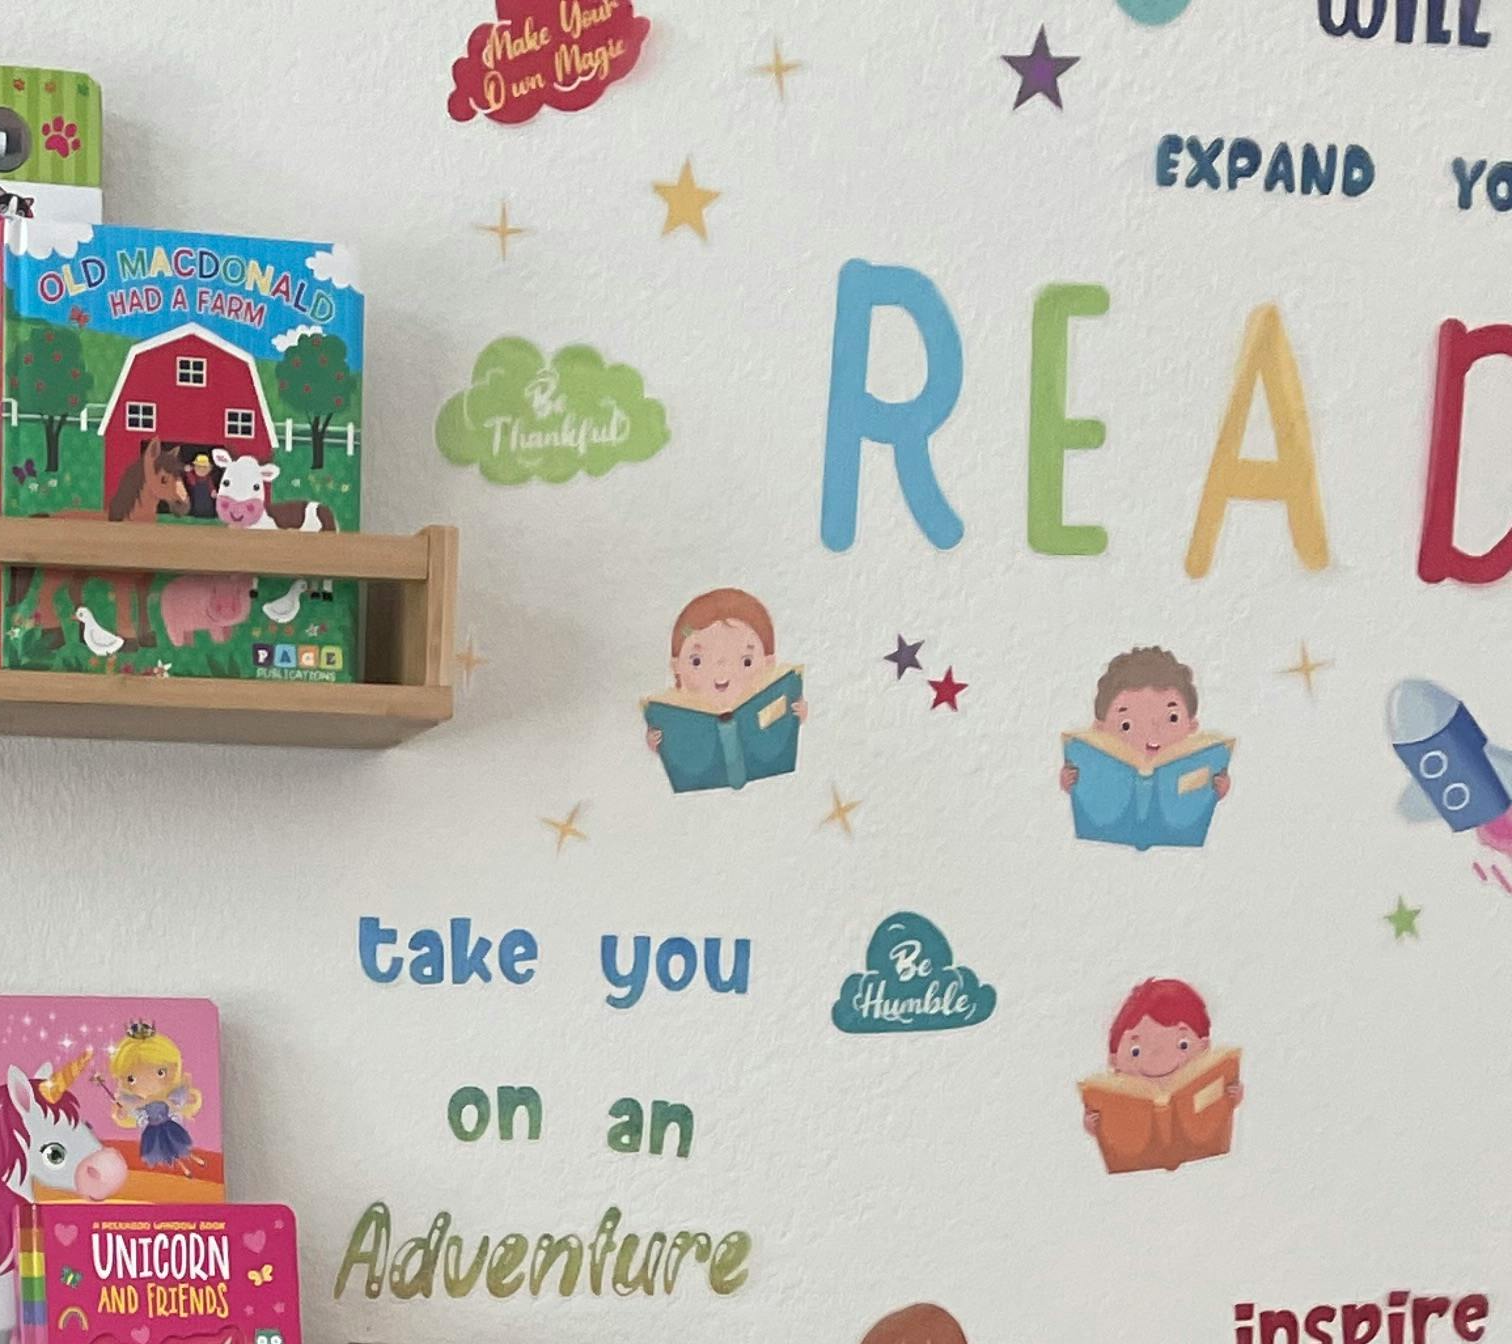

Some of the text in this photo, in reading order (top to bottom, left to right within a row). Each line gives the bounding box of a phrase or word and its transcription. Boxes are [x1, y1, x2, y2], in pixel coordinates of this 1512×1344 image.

[483, 18, 551, 68] Make
[1318, 0, 1491, 47] WILL
[484, 39, 626, 110] Own Magic
[1156, 134, 1512, 212] EXPAND YO
[39, 246, 335, 323] OLD MACDONALD
[107, 287, 267, 327] HAD A FARM
[525, 369, 568, 419] Be
[820, 257, 1512, 584] READ
[483, 400, 630, 456] Thankful
[358, 916, 751, 1010] take you
[890, 940, 932, 982] Be
[448, 1086, 694, 1158] on an
[92, 1232, 230, 1281] UNICORN
[333, 1201, 752, 1300] Adventure
[97, 1282, 230, 1319] AND FRIENDS
